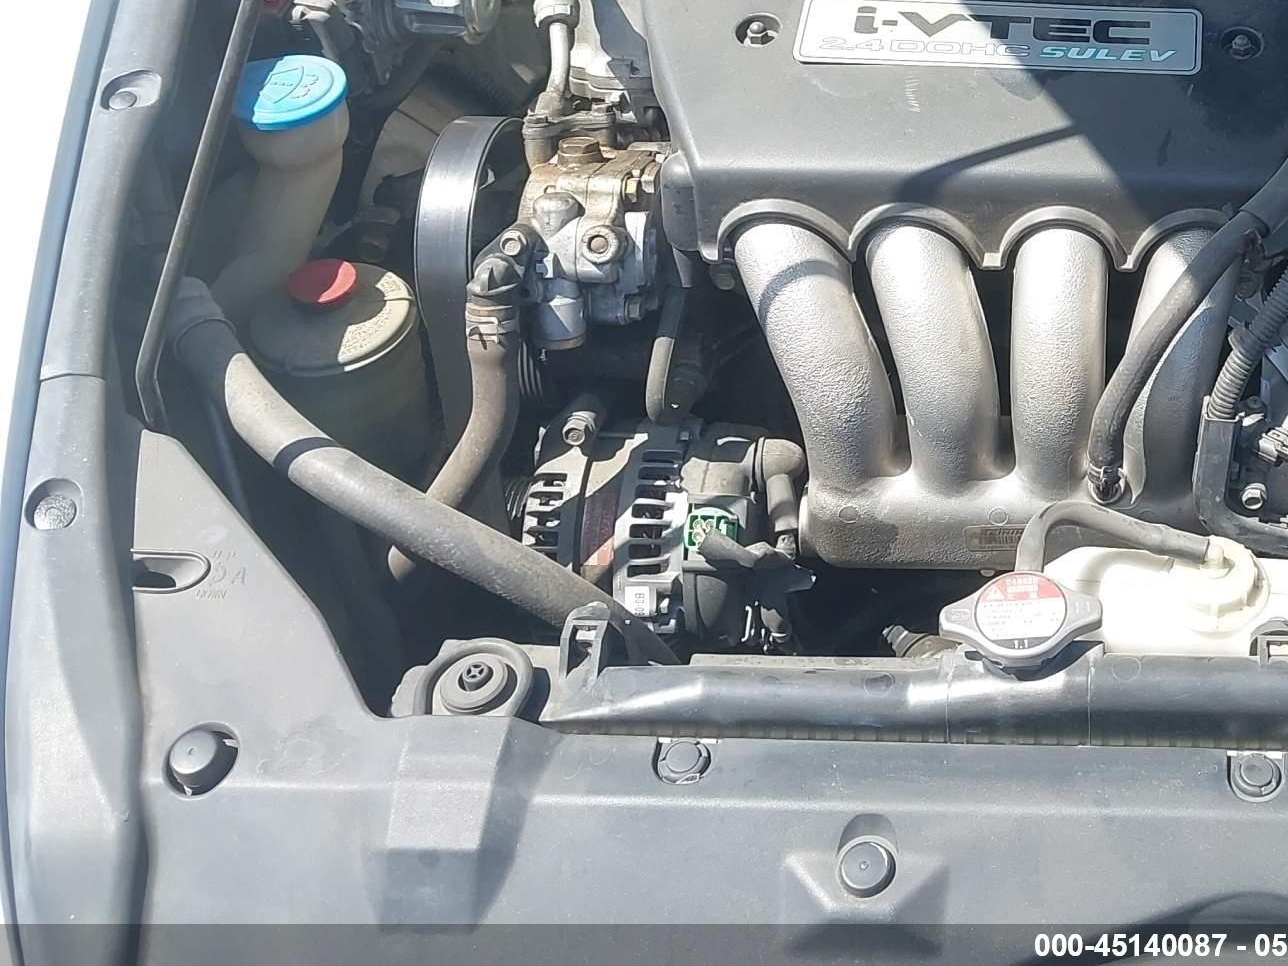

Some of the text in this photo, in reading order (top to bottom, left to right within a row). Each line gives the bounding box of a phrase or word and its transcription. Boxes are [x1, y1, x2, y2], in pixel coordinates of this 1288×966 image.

[853, 5, 1151, 44] i-VTEC
[1039, 46, 1176, 63] SULEV
[1013, 640, 1029, 649] 1.1
